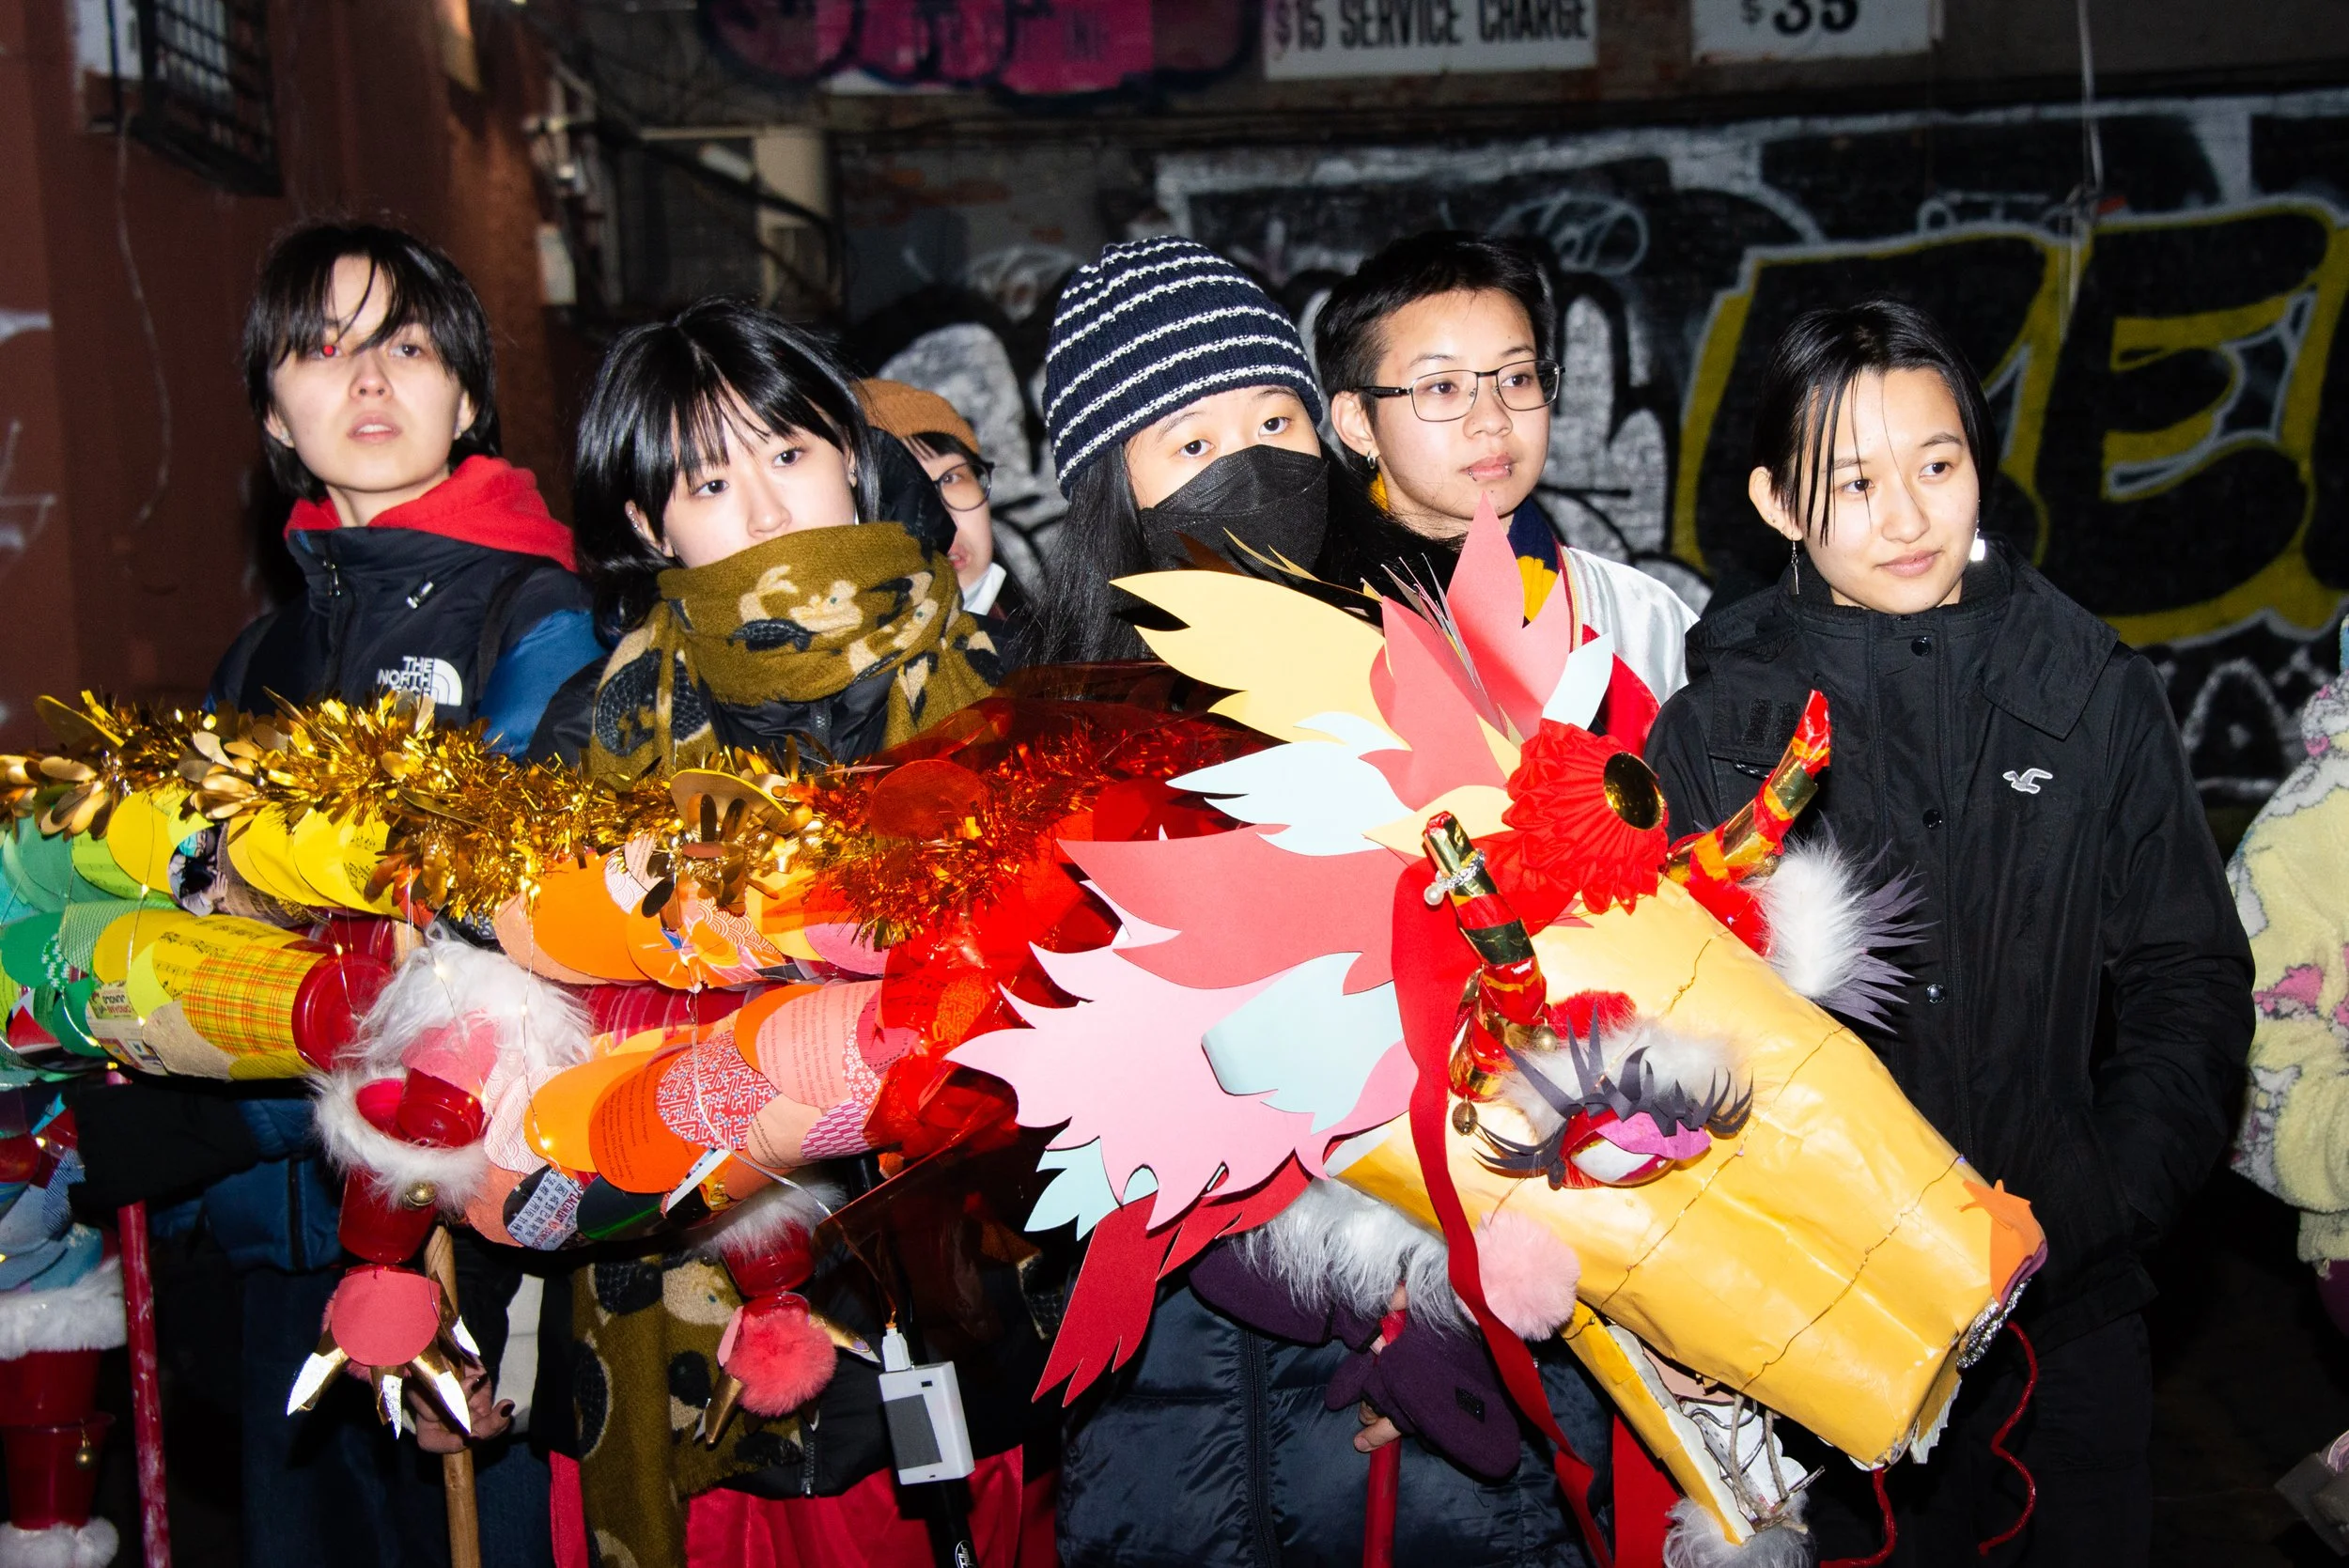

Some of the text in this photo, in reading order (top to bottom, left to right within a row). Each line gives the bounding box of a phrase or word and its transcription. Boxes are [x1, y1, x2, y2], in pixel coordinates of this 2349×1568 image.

[1340, 0, 1461, 48] SERVICE
[1478, 0, 1588, 43] CHARGE
[402, 656, 433, 673] THE
[377, 668, 431, 686] NORTH
